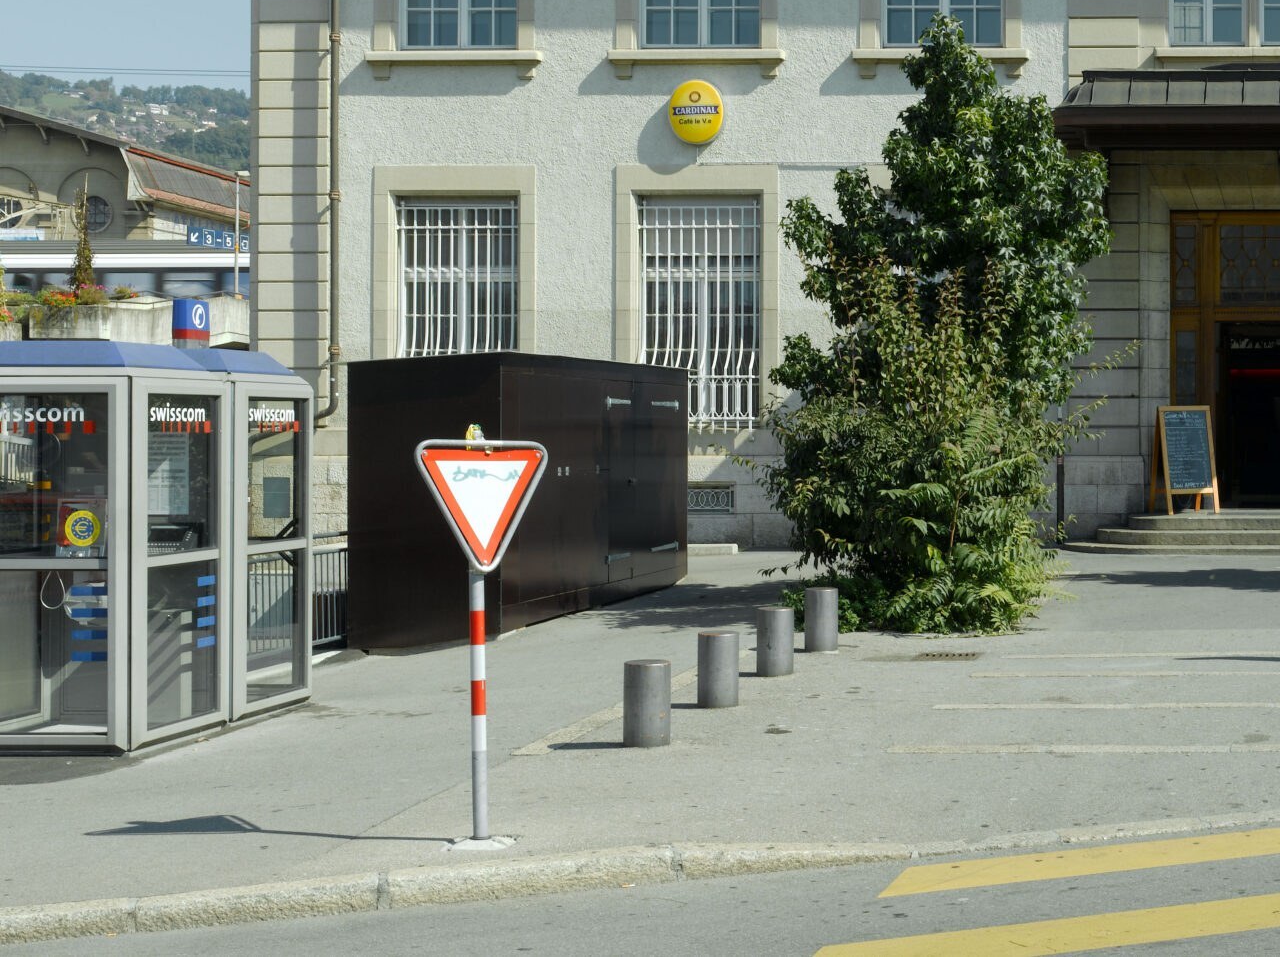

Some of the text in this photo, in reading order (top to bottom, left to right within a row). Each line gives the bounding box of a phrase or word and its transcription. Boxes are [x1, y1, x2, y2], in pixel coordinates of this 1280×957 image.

[675, 106, 717, 115] CARDINAL
[206, 234, 212, 244] 3
[226, 237, 232, 247] 5
[0, 402, 85, 423] isscom
[150, 403, 206, 422] swisscom
[249, 404, 296, 422] swisscom
